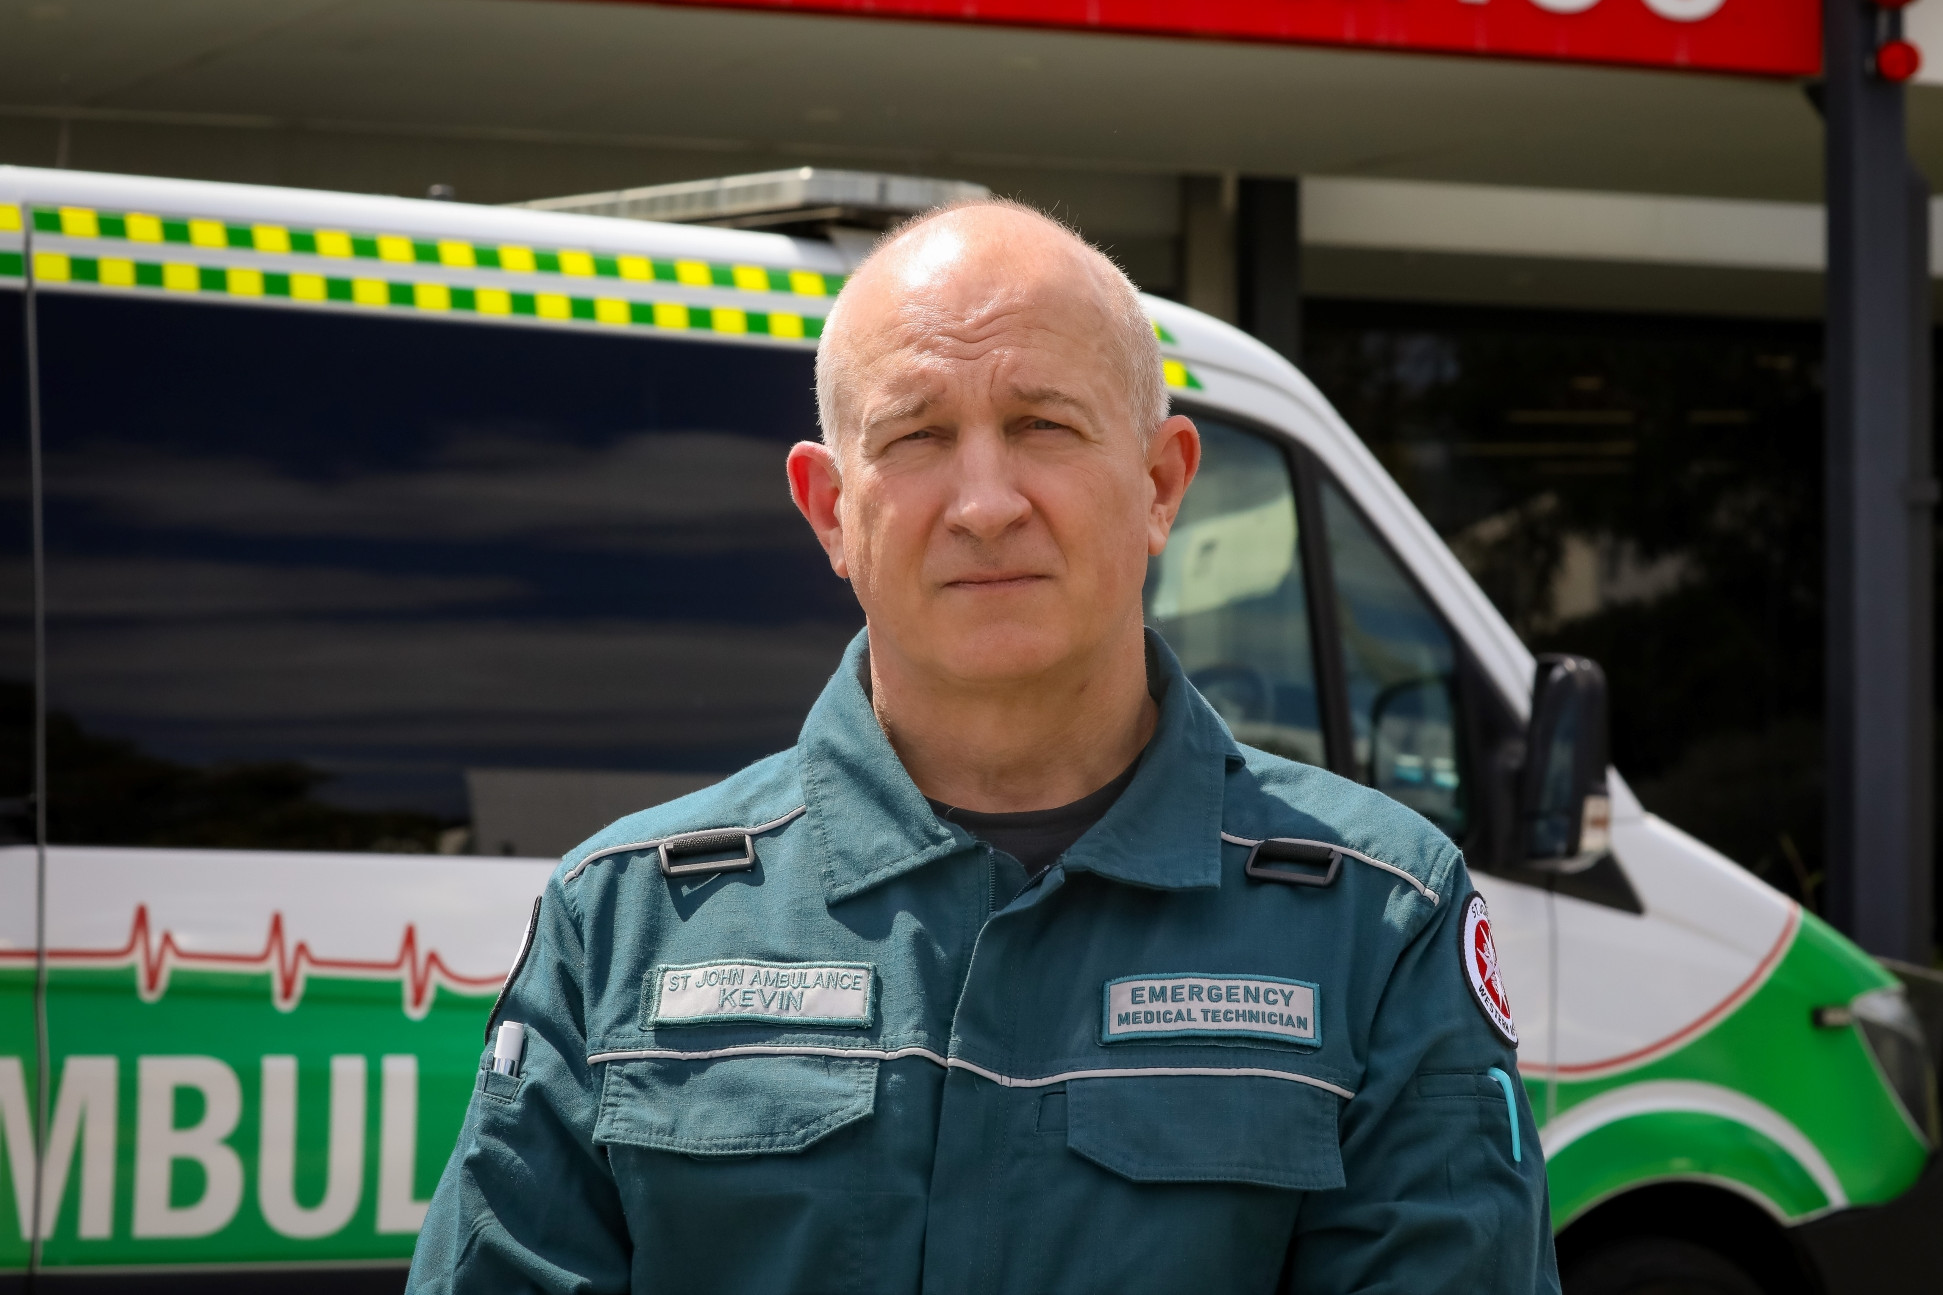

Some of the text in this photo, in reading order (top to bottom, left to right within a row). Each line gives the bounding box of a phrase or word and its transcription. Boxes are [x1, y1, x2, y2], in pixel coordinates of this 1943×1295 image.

[668, 968, 863, 991] ST JOHN AMBULANCE
[718, 988, 804, 1011] KEVIN
[1131, 984, 1294, 1007] EMERGENCY
[1117, 1008, 1308, 1030] MEDICAL TECHNICIAN
